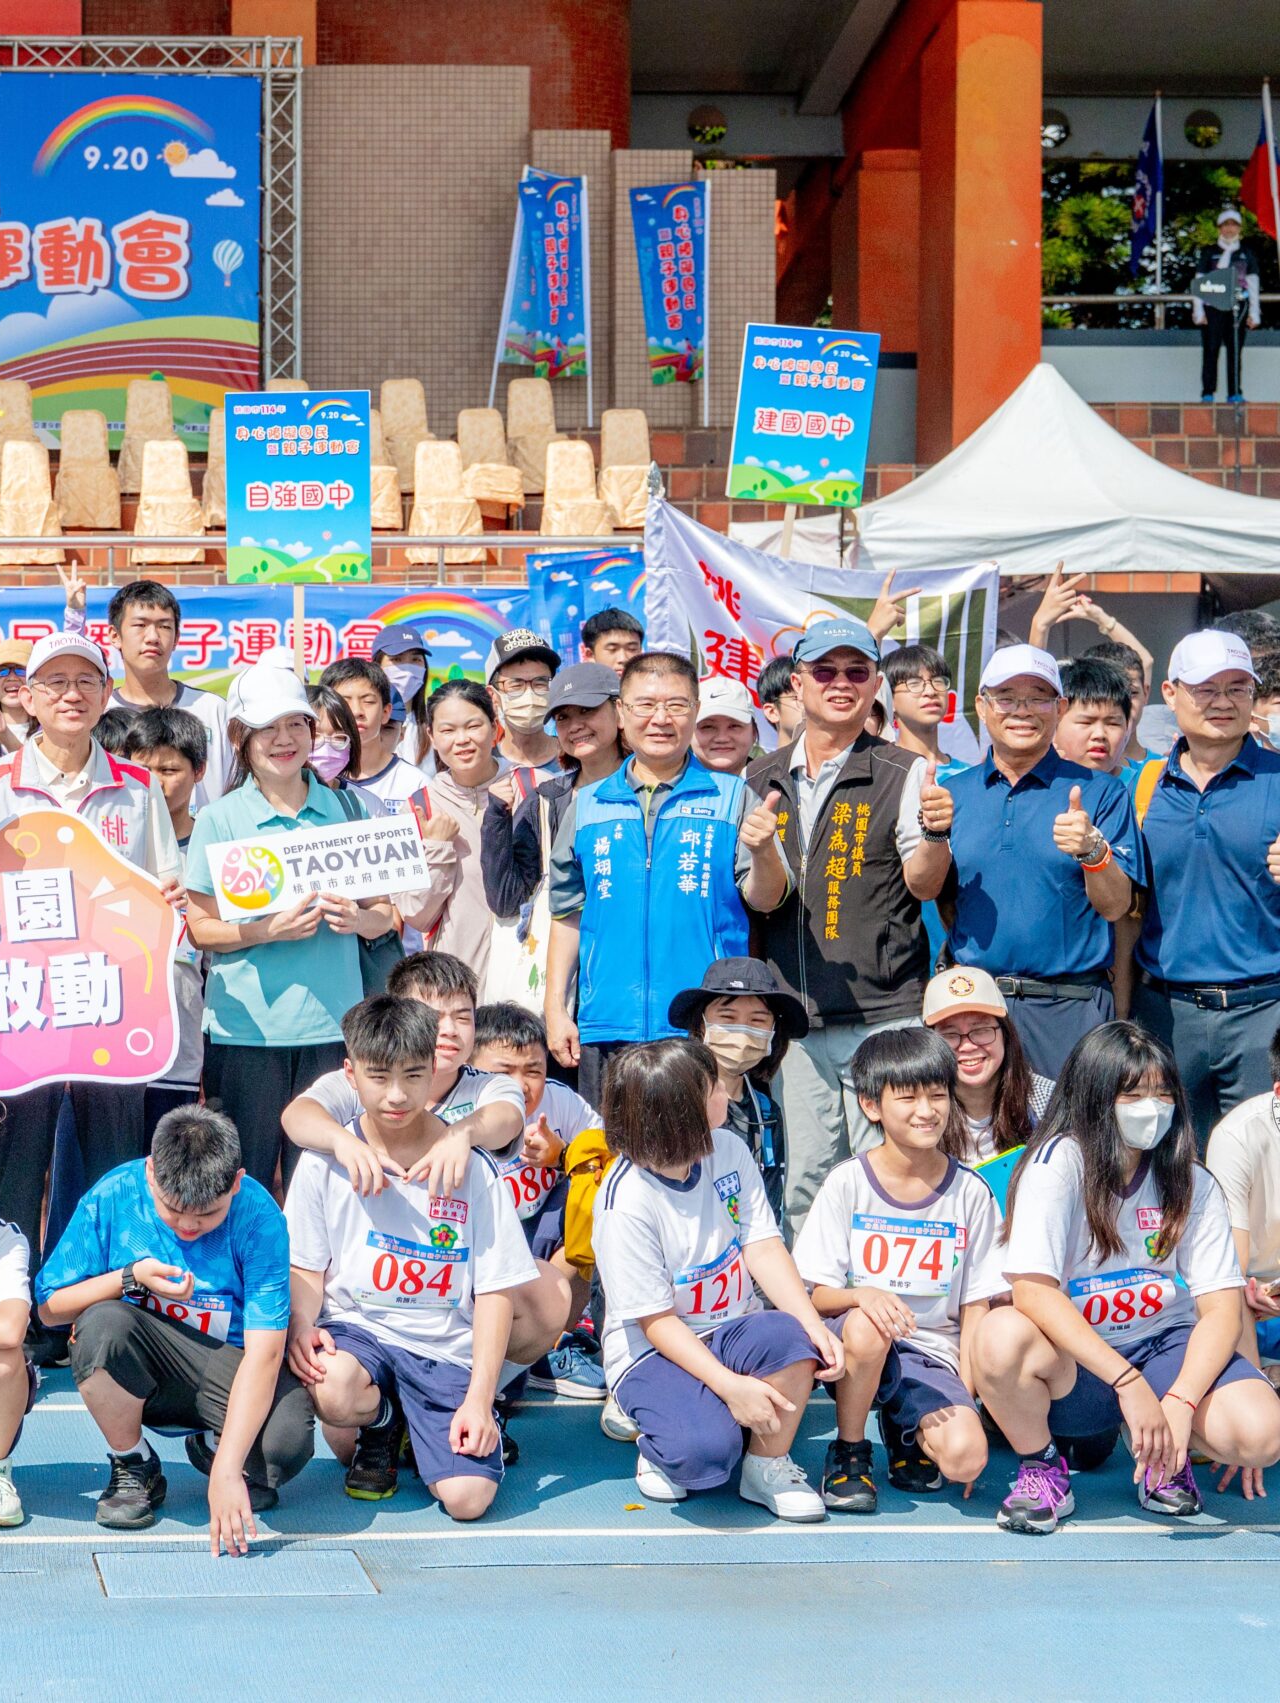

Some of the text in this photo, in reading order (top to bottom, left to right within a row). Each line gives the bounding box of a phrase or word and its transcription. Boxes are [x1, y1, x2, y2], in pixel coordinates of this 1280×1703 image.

[84, 145, 148, 172] 9.20
[755, 409, 852, 438] 建國國中
[248, 482, 352, 509] 自強國中
[283, 827, 414, 855] DEPARTMENT OF SPORTS
[286, 840, 420, 878] TAOYUAN
[851, 803, 870, 877] 桃園市議員
[292, 864, 424, 895] 桃園市政府體育局
[677, 829, 701, 896] 邱若華
[372, 1253, 454, 1297] 084
[863, 1233, 944, 1281] 074
[687, 1259, 741, 1315] 127
[1082, 1283, 1163, 1326] 088
